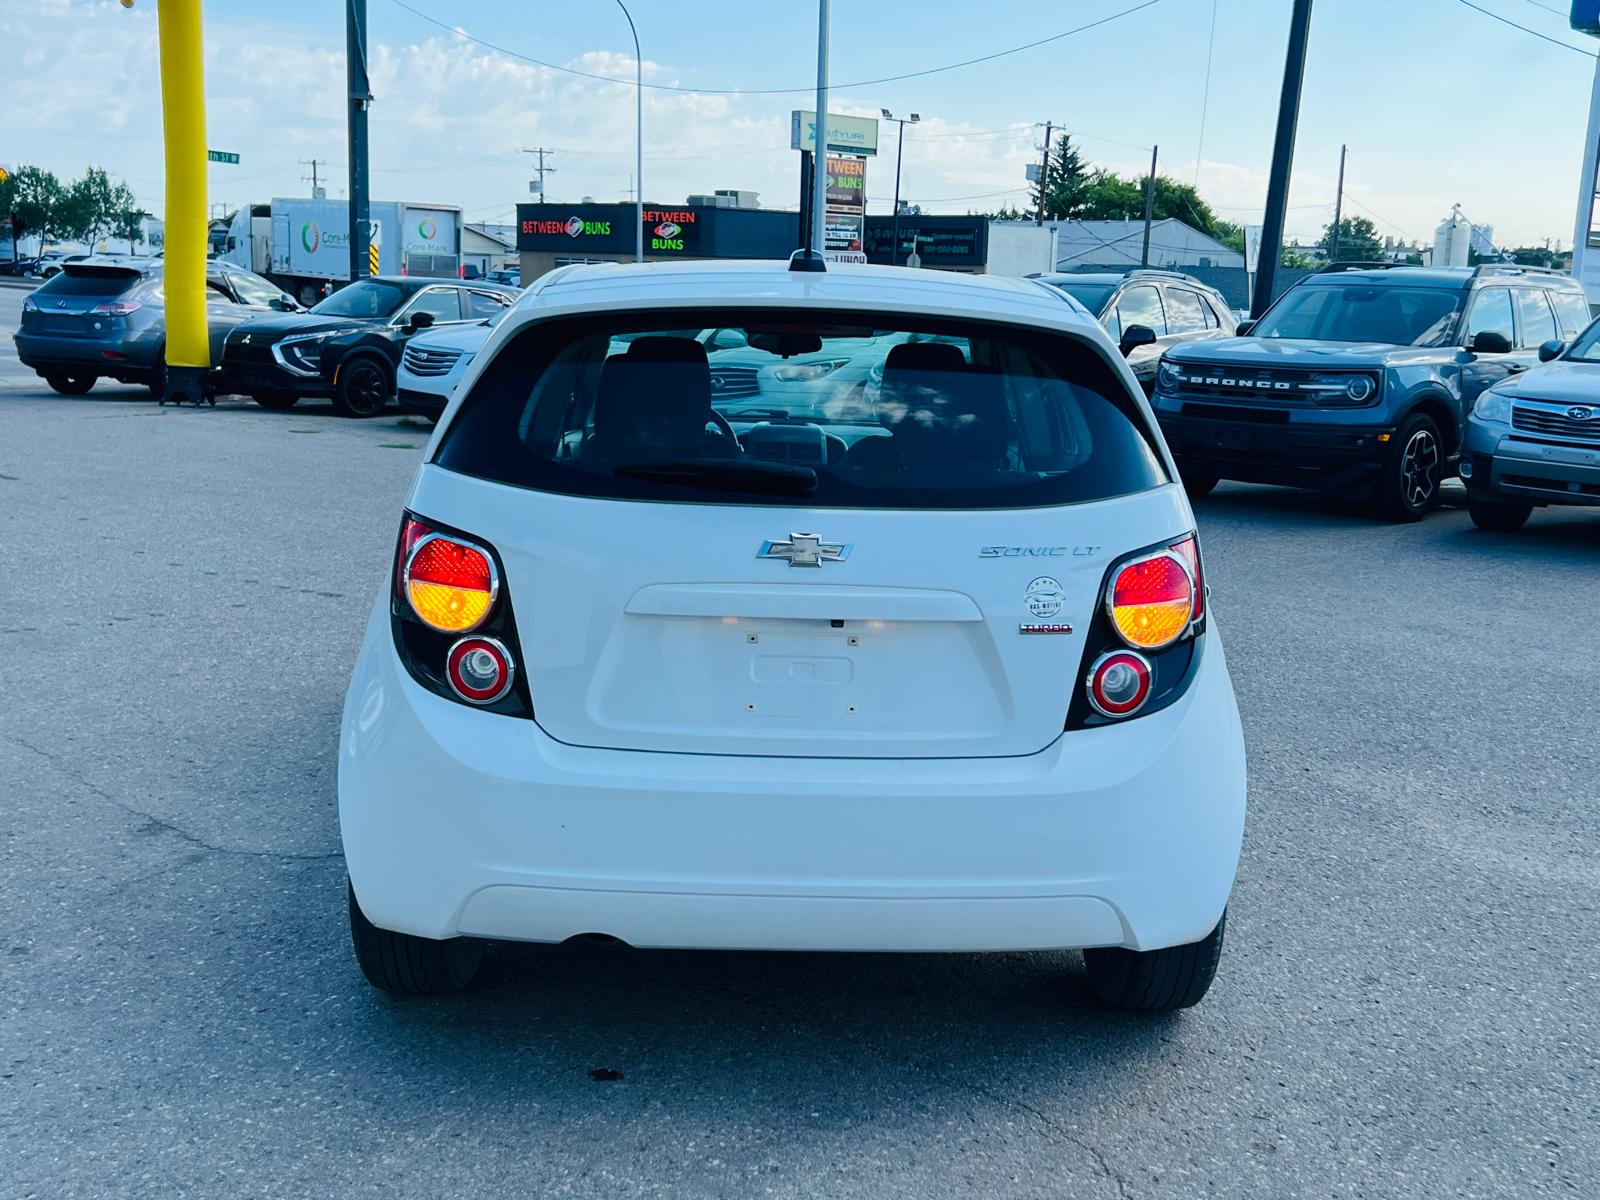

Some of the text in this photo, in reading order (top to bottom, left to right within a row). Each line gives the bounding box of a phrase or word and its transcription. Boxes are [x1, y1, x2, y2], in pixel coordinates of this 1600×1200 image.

[230, 154, 238, 163] W
[827, 160, 864, 176] TWEEN
[838, 176, 863, 190] BUNS
[641, 211, 695, 223] BETWEEN
[522, 221, 611, 235] BETWEEN BUNS
[321, 230, 351, 245] Core-M
[652, 238, 685, 250] BUNS
[1190, 376, 1290, 389] BRONCO
[979, 545, 1103, 558] SONIC LT
[1023, 624, 1071, 633] TURBO
